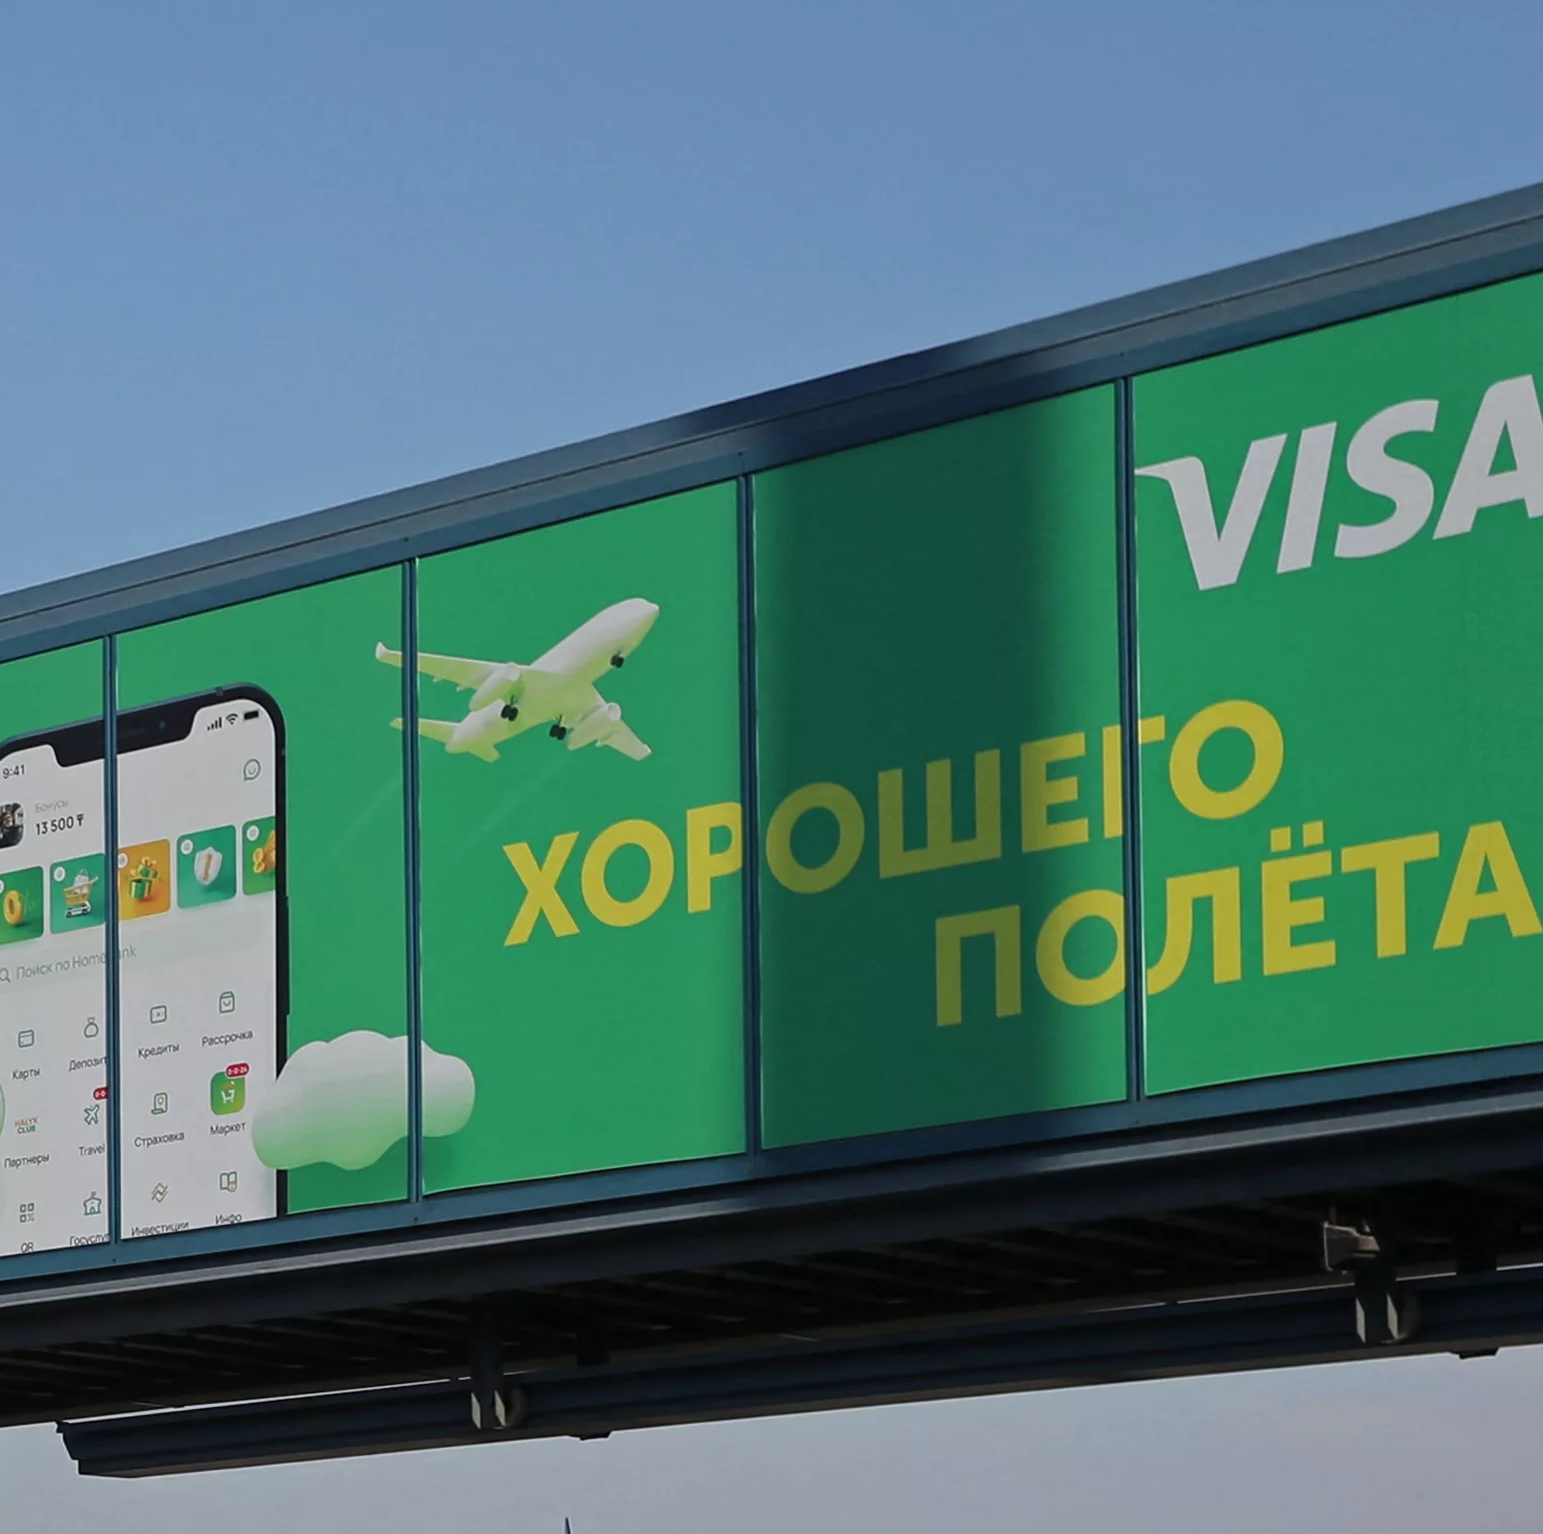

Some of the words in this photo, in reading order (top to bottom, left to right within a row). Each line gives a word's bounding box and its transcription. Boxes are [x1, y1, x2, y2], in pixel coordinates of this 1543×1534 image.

[1134, 373, 1543, 591] VISA
[2, 764, 26, 779] 9:41
[36, 821, 48, 836] 13
[50, 815, 74, 832] 500
[502, 698, 1284, 947] ХОРОШЕГО
[935, 819, 1543, 1028] ПОЛЁТА
[16, 961, 53, 980] Поиск
[55, 958, 70, 973] по
[201, 1029, 254, 1047] Рассрочка
[138, 1043, 180, 1059] Кредиты
[12, 1068, 40, 1081] Карты
[17, 1125, 36, 1135] CLUB
[210, 1121, 246, 1136] Маркет
[134, 1131, 185, 1148] Страховка
[78, 1143, 105, 1157] Travel
[4, 1153, 50, 1169] Партнеры
[215, 1212, 243, 1225] Инфо
[131, 1220, 190, 1237] Инвестиции
